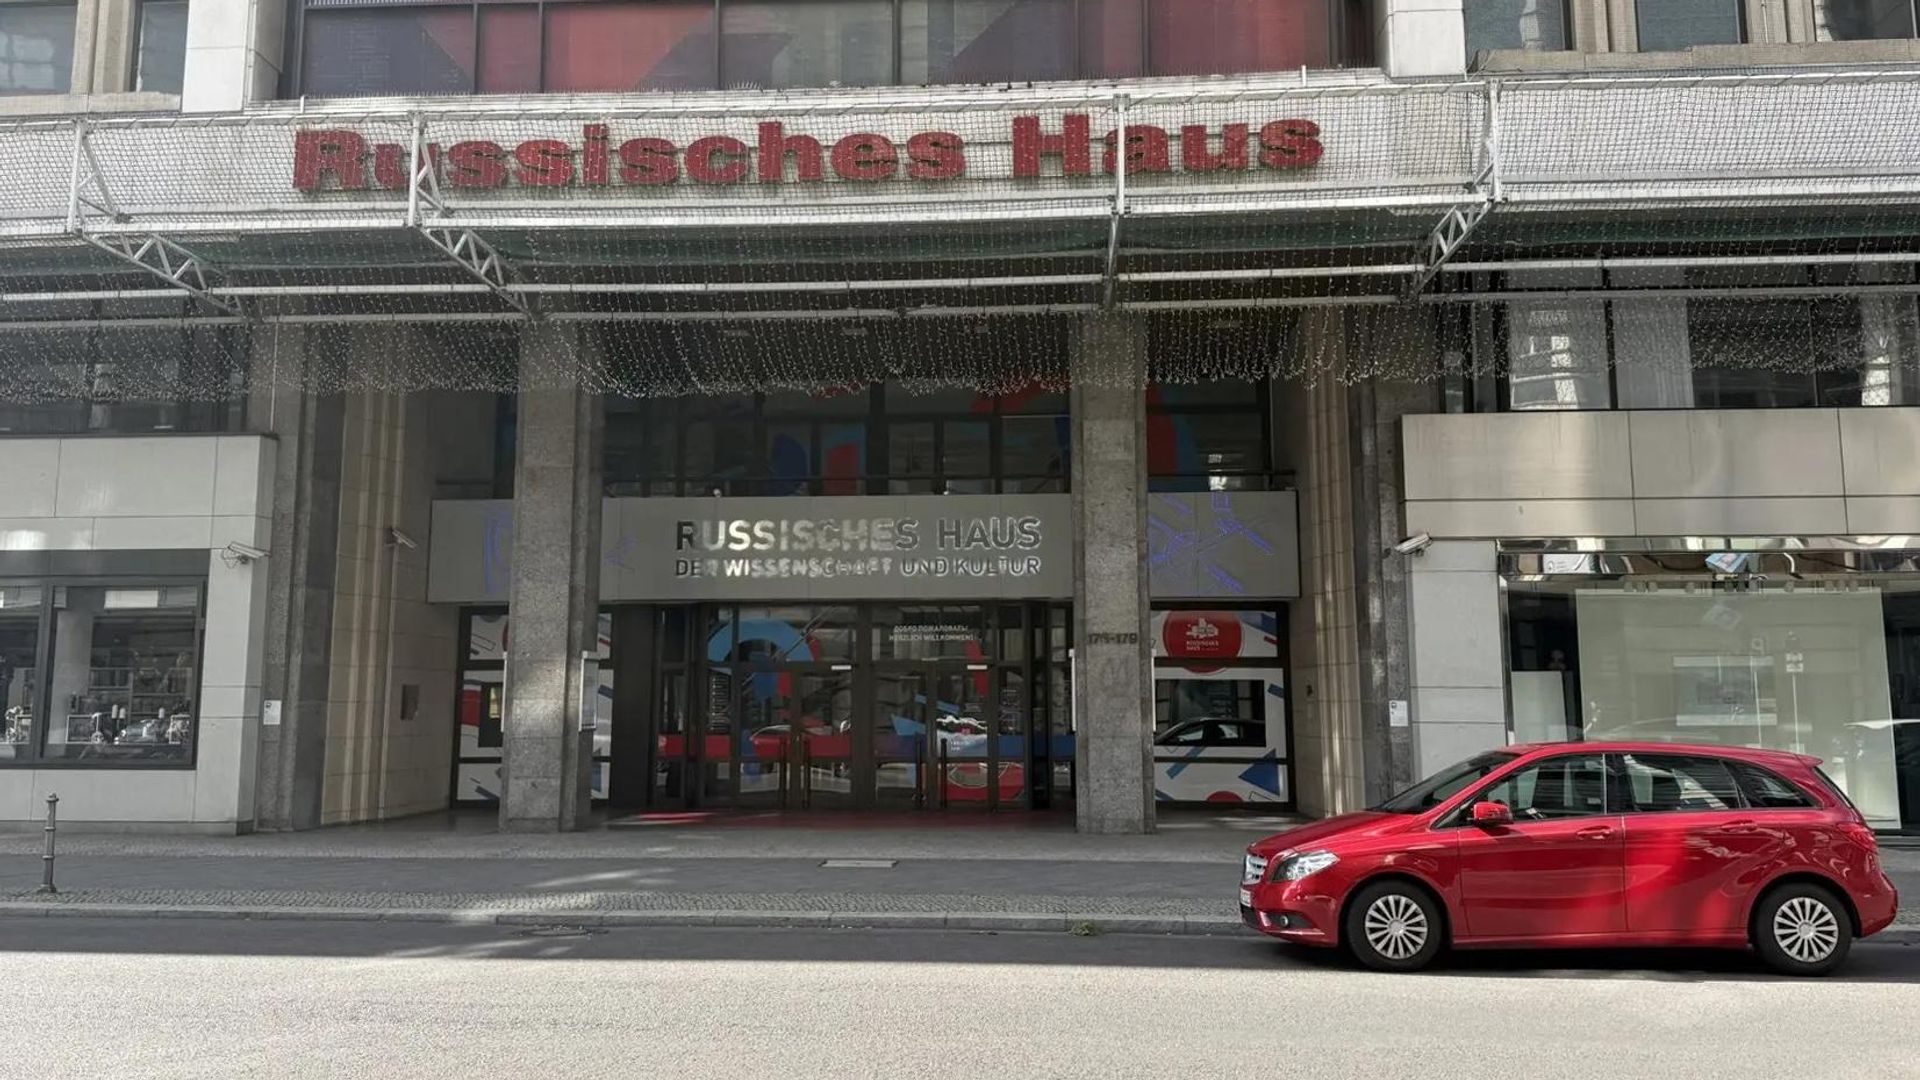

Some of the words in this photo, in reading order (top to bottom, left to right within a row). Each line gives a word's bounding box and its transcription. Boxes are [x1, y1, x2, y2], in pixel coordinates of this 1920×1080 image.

[293, 121, 966, 190] Russisches
[1012, 114, 1324, 177] Haus
[676, 518, 919, 551] RUSSISCHES
[937, 516, 1042, 550] HAUS
[675, 557, 719, 578] DER
[723, 556, 893, 578] WISSENSCHAFT
[901, 556, 949, 577] UND
[953, 555, 1042, 577] KULTUR
